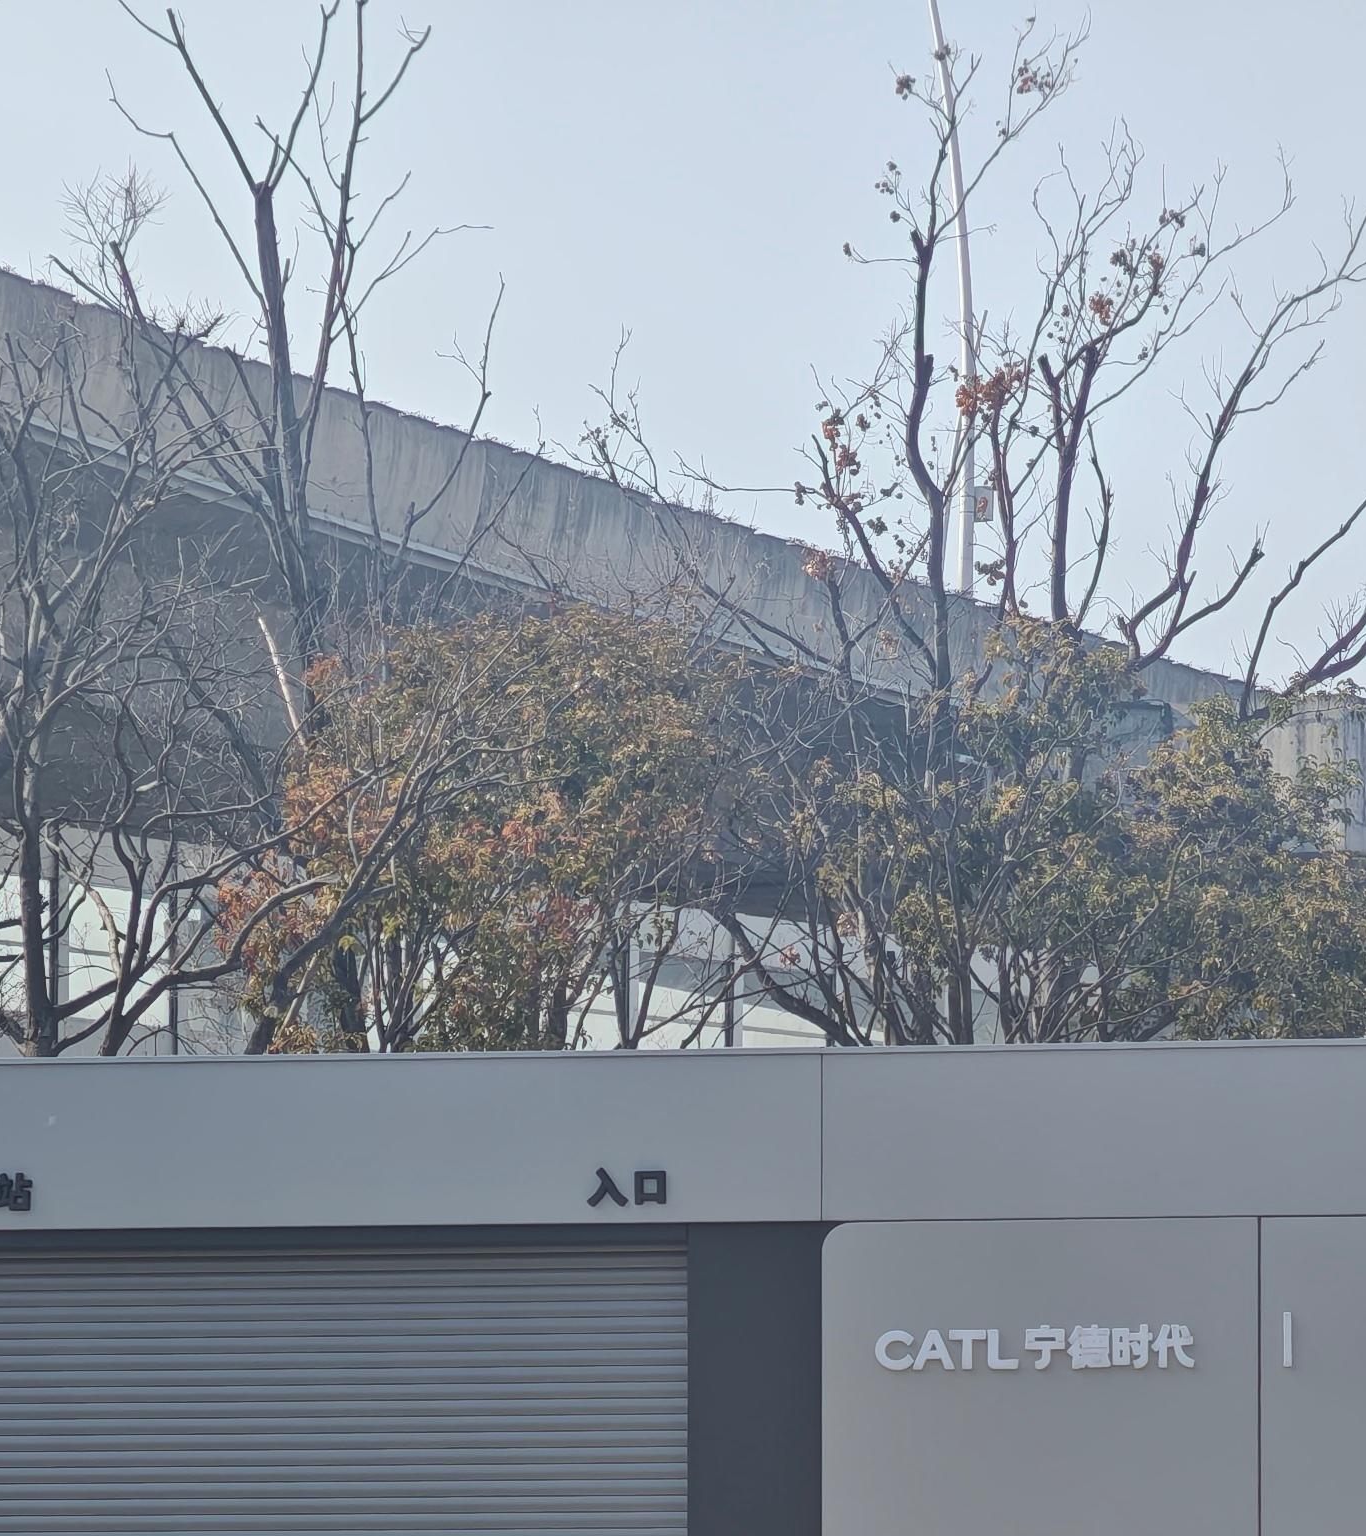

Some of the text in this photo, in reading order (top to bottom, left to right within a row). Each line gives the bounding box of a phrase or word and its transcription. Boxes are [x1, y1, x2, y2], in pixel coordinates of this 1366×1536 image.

[587, 1167, 667, 1207] 入口
[874, 1324, 1195, 1370] CATL 宁德时代
